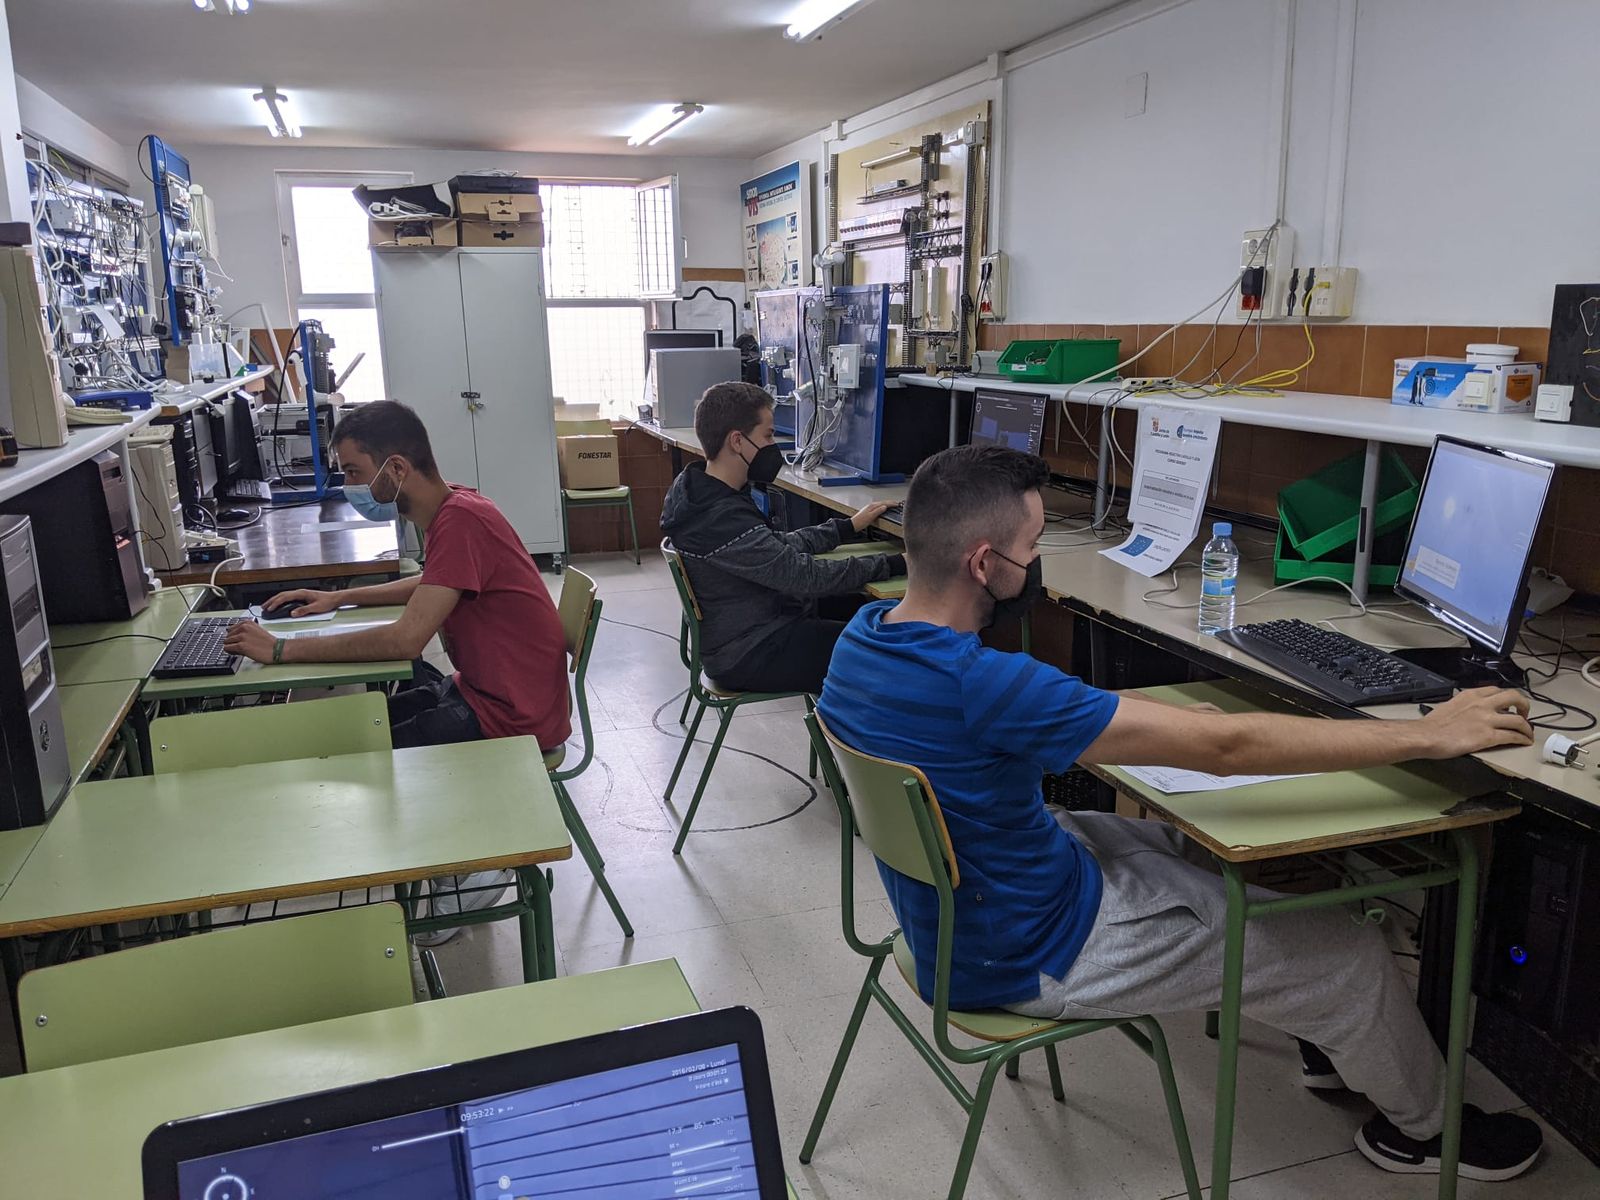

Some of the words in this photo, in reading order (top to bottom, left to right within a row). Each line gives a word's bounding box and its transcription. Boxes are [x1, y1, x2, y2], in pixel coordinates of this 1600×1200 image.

[578, 451, 612, 459] FONESTAR
[710, 1059, 727, 1068] Lundi
[460, 1107, 494, 1122] 09:53:22
